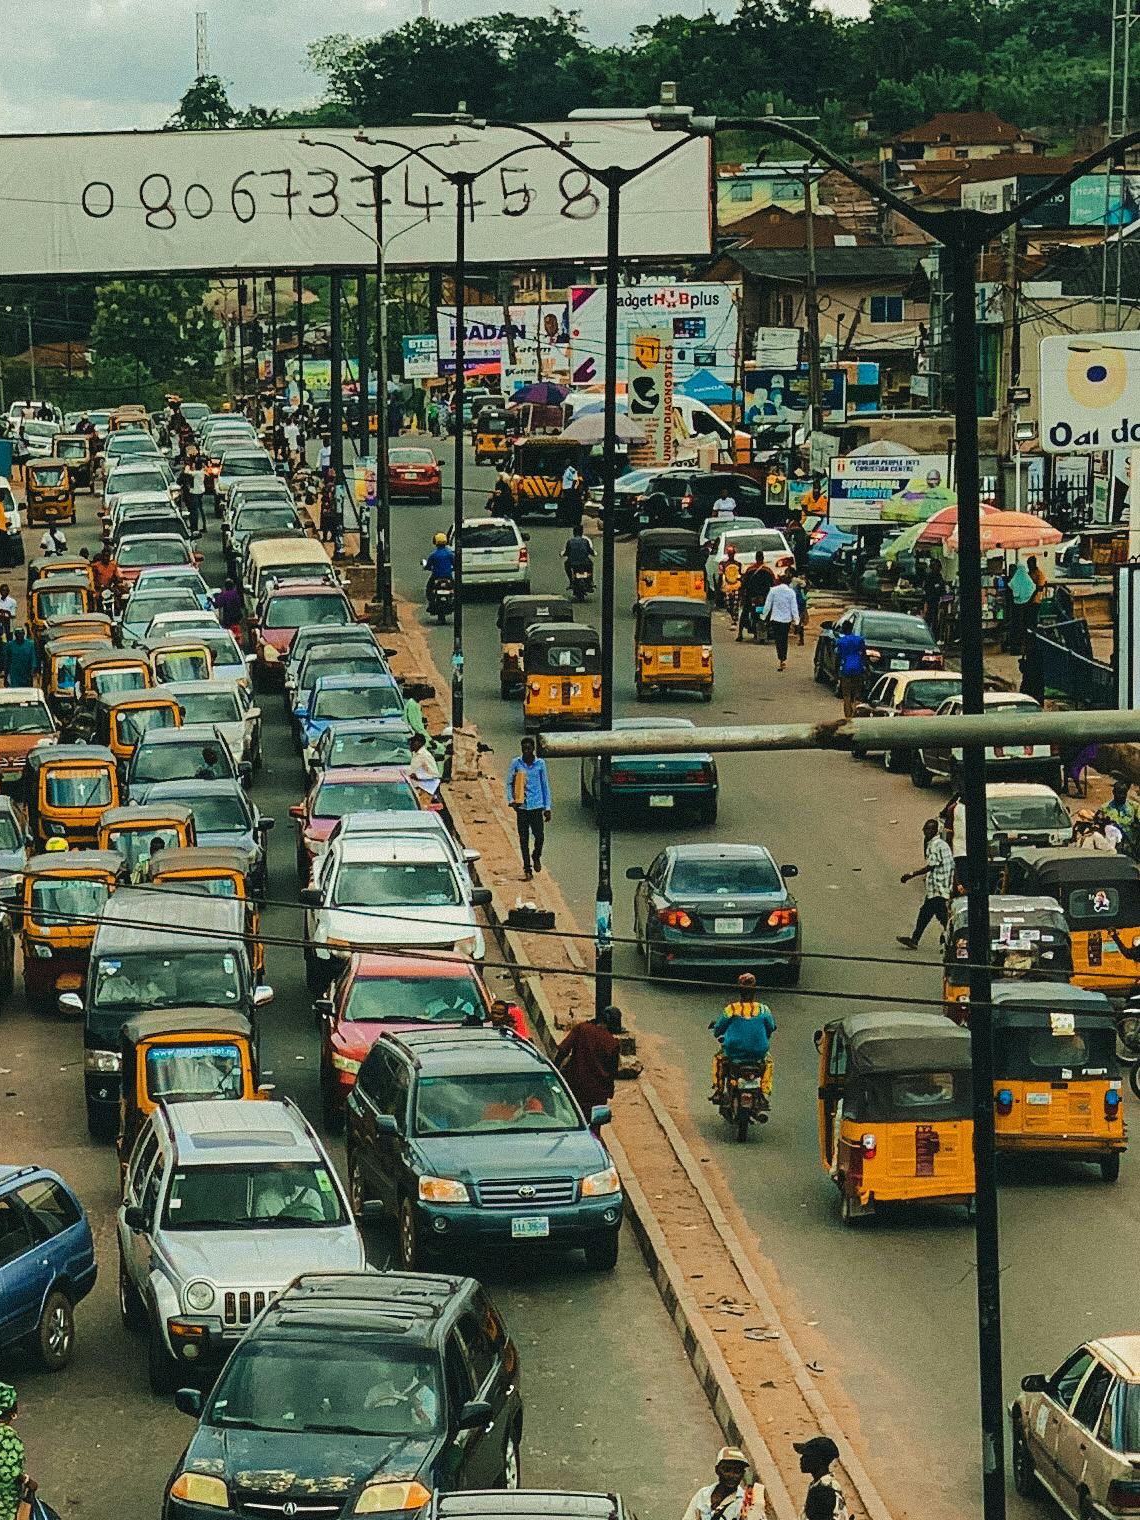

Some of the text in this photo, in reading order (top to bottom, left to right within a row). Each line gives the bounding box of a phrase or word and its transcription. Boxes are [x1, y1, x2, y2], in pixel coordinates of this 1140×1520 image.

[450, 324, 526, 341] IADAN
[663, 345, 673, 461] UNION DIAGNOSTICS
